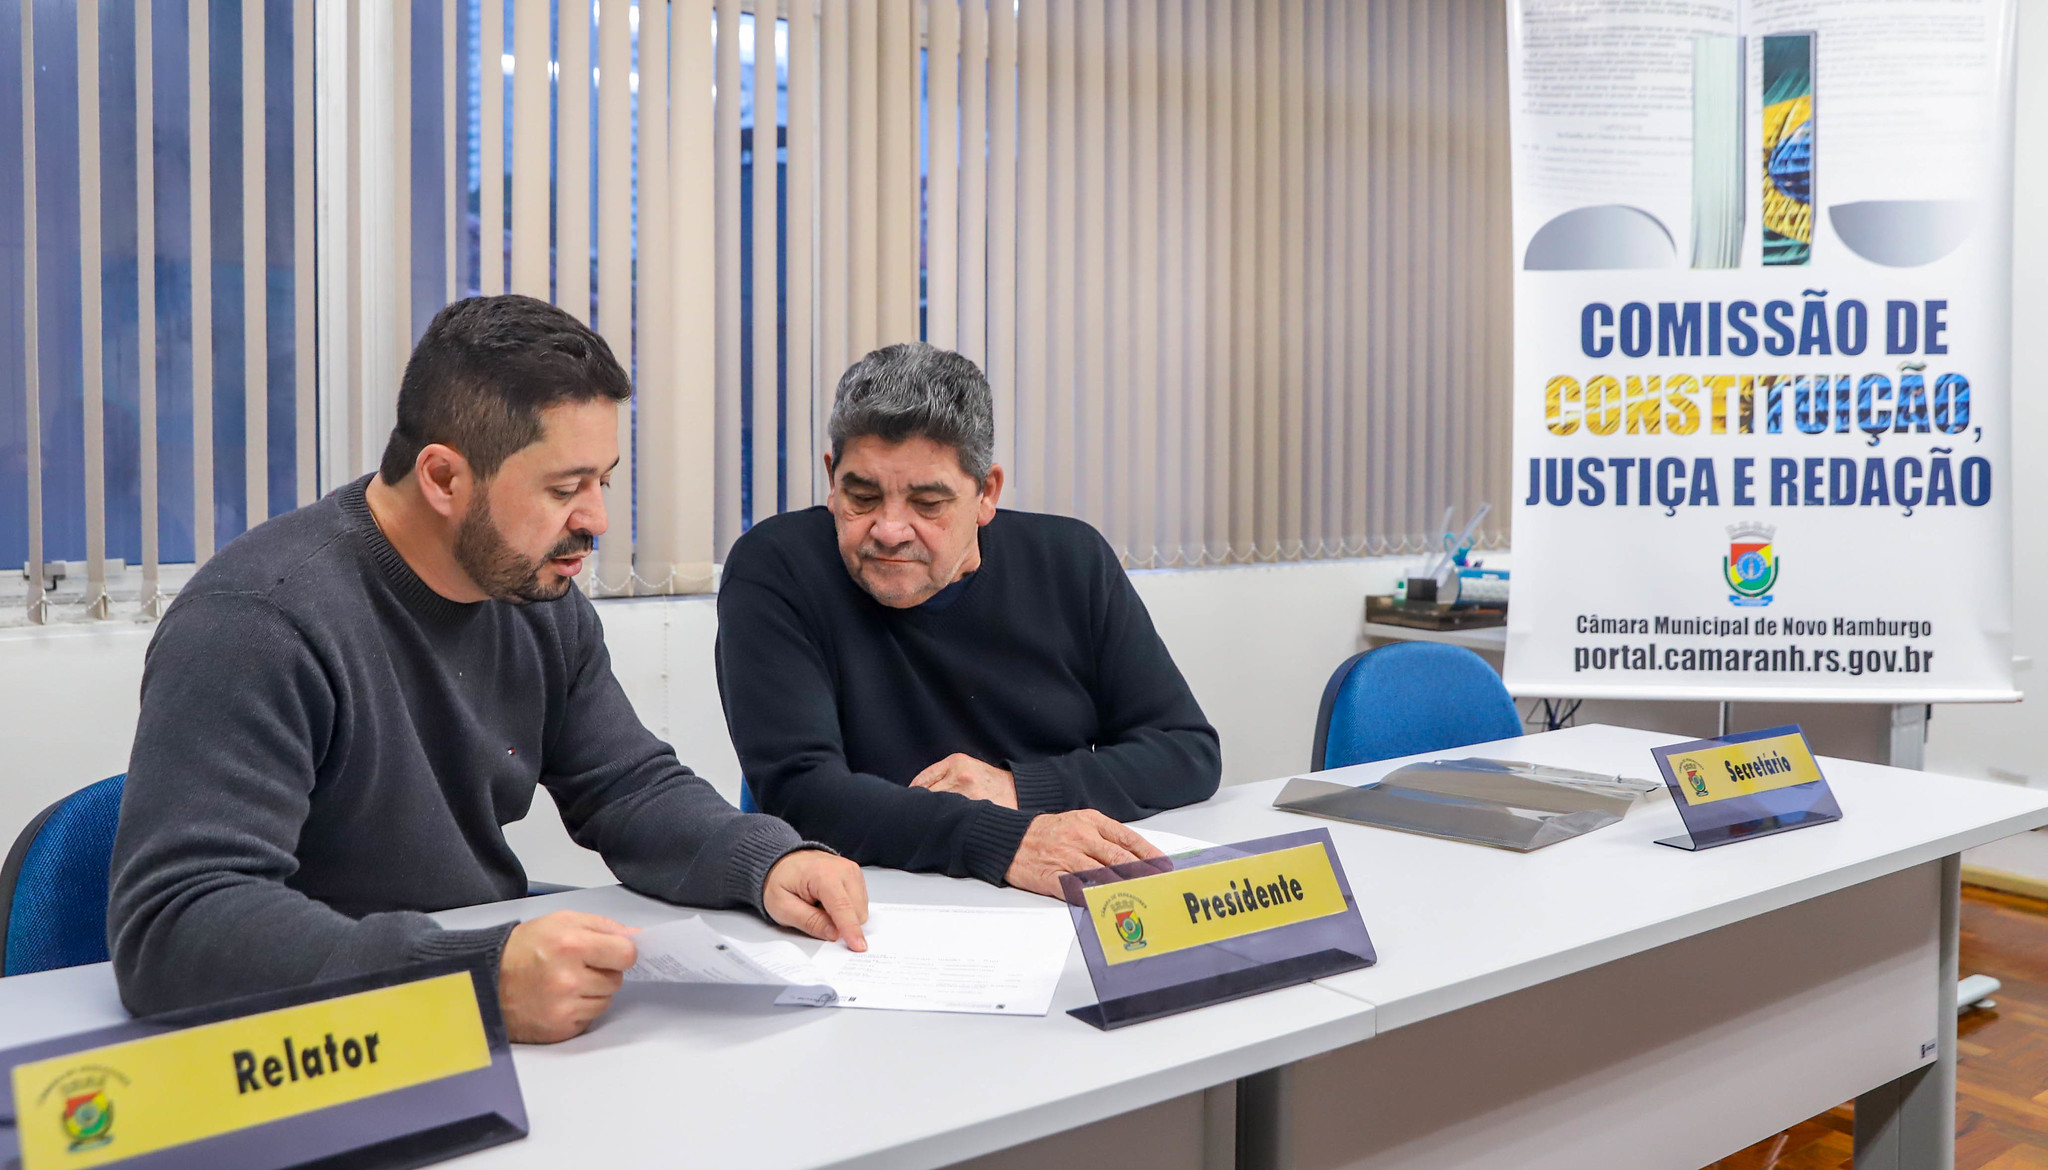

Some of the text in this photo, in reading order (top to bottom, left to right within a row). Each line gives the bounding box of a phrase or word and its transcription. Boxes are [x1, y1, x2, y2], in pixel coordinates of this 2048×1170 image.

[1580, 288, 1949, 359] COMISSÃO DE
[1545, 361, 1983, 447] CONSTITUIÇÃO,
[1525, 446, 1993, 518] JUSTIÇA E REDAÇÃO
[1576, 614, 1932, 639] Câmara Municipal de Novo Hamburgo
[1574, 643, 1934, 676] portal.camaranh.rs.gov.br
[1724, 750, 1791, 783] Secretário
[1182, 873, 1304, 924] Presidente
[233, 1032, 380, 1095] Relator
